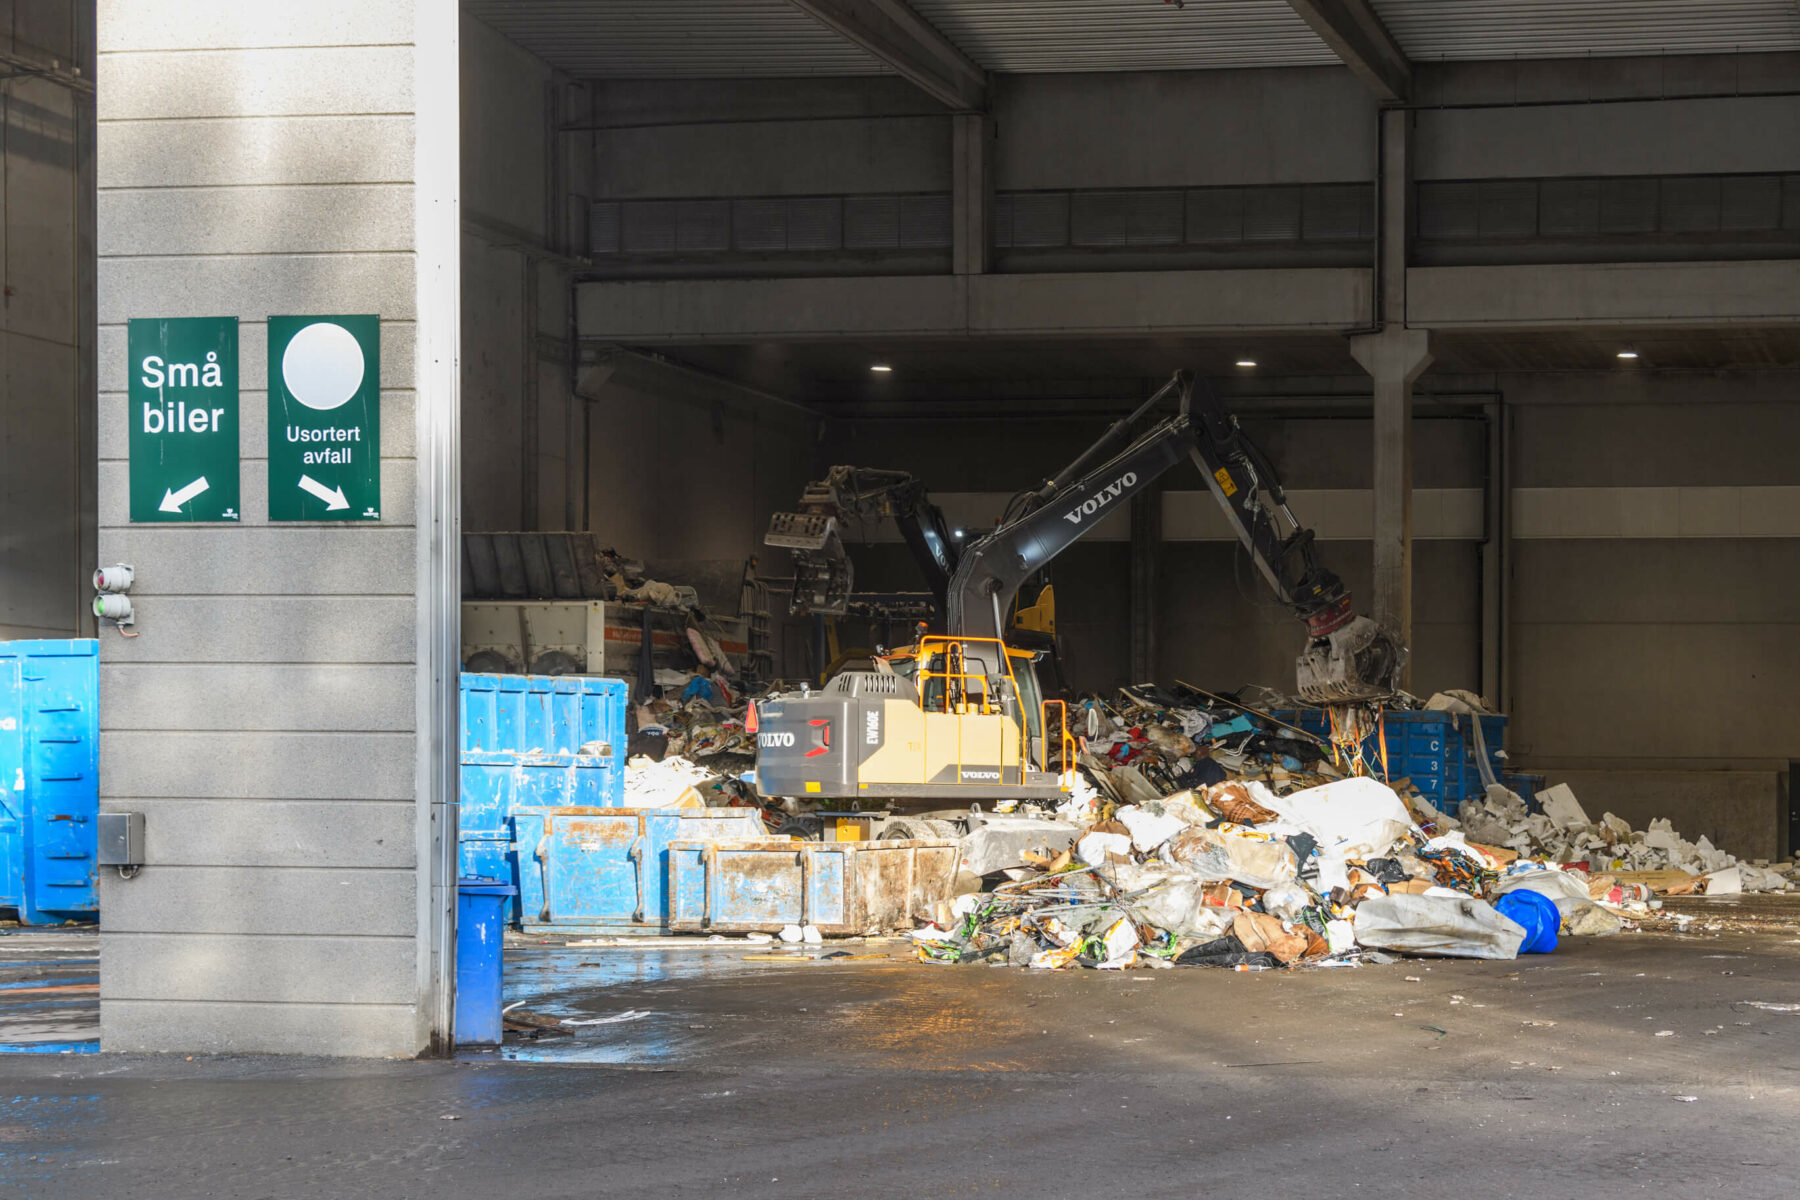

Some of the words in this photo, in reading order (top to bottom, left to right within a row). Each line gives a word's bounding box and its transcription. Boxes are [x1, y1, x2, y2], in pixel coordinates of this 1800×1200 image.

[141, 351, 223, 389] Små
[143, 401, 225, 433] biler
[286, 425, 361, 442] Usortert
[303, 447, 352, 464] avfall
[1063, 471, 1137, 525] VOLVO
[866, 710, 878, 744] EW160E
[757, 732, 795, 747] VOLVO
[960, 771, 999, 780] VOLVO
